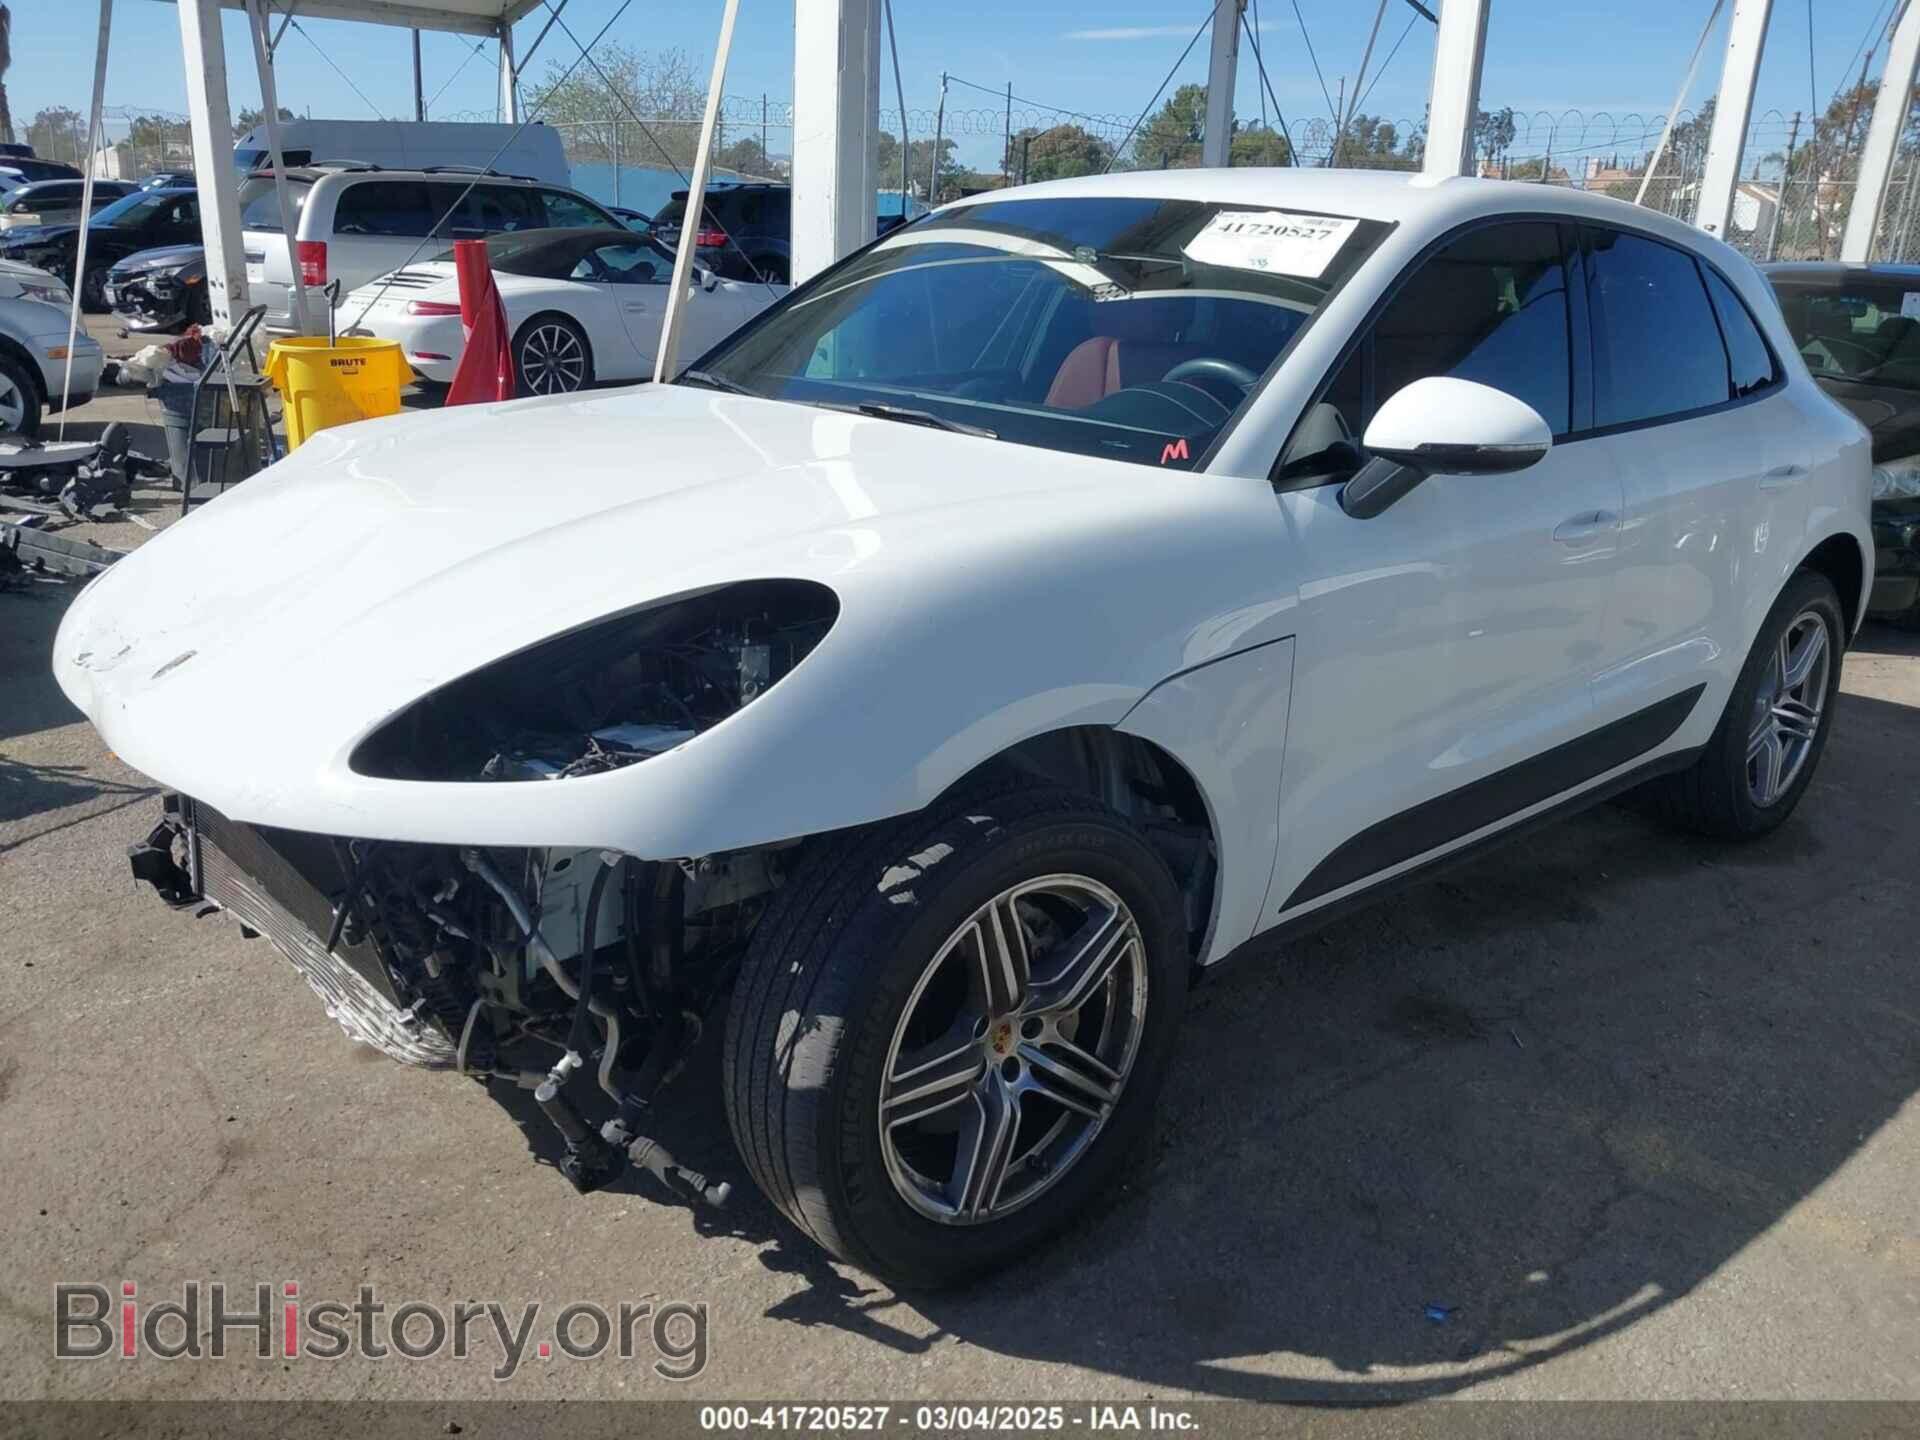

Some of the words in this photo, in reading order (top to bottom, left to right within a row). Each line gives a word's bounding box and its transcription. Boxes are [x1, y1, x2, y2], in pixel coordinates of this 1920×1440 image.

[1218, 222, 1332, 241] 41720527
[330, 357, 367, 367] BRUTE
[1161, 438, 1189, 464] M
